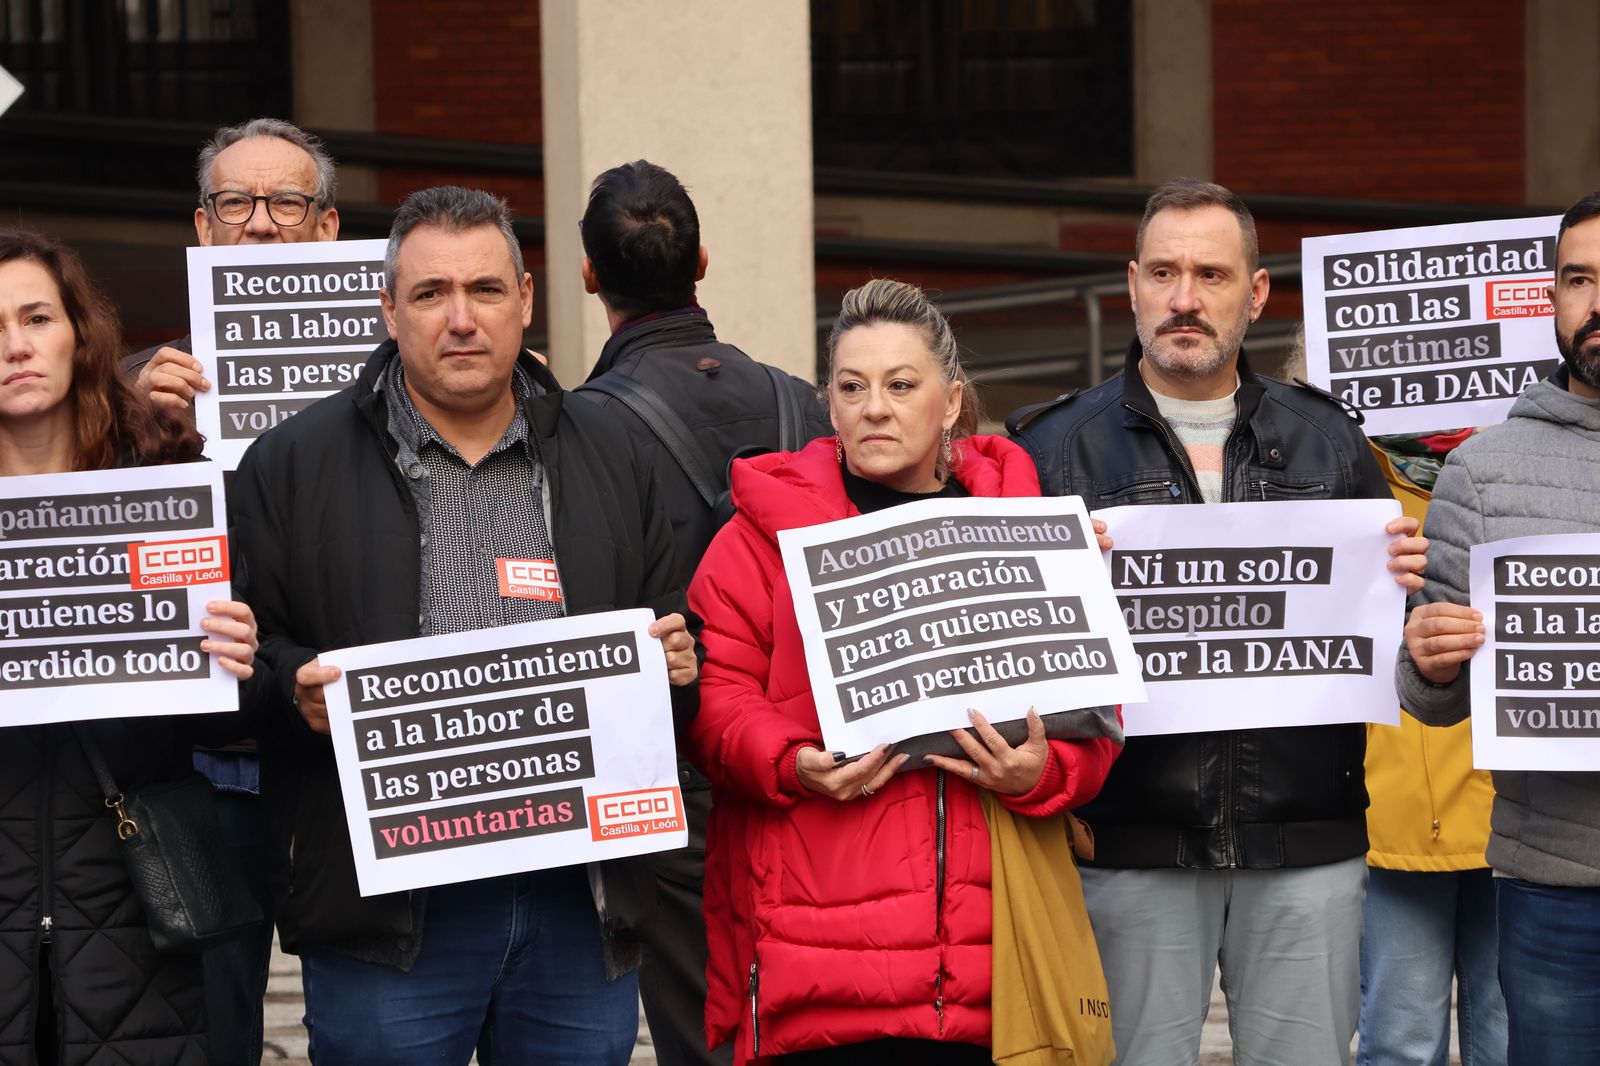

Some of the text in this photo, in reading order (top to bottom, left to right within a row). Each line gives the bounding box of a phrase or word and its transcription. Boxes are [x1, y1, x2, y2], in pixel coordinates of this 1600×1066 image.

[1332, 240, 1546, 286] Solidaridad
[225, 312, 377, 342] a la labor
[1335, 292, 1460, 328] con las
[1493, 307, 1527, 316] Castilla
[1336, 334, 1490, 369] víctimas
[226, 361, 273, 387] las
[1341, 366, 1541, 410] de la DANA
[145, 547, 214, 567] CCOO
[818, 520, 1072, 576] Acompañamiento
[140, 569, 223, 585] Castilla y León
[1120, 551, 1319, 586] Ni un solo
[509, 584, 545, 596] Castilla
[548, 590, 554, 600] y
[825, 560, 1034, 627] y reparación
[0, 594, 176, 638] quienes lo
[1121, 595, 1272, 638] despido
[1505, 614, 1524, 634] a
[1533, 608, 1565, 634] la
[837, 600, 1076, 673] para quienes lo
[0, 644, 200, 682] erdido todo
[358, 644, 632, 702] Reconocimiento
[1135, 639, 1364, 676] or la DANA
[1505, 654, 1553, 682] las
[847, 645, 1108, 713] han perdido todo
[366, 698, 574, 751] a la labor de
[370, 750, 581, 800] las personas
[380, 800, 574, 848] voluntarias
[604, 798, 669, 819] CCOO
[600, 818, 678, 837] Castilla y León
